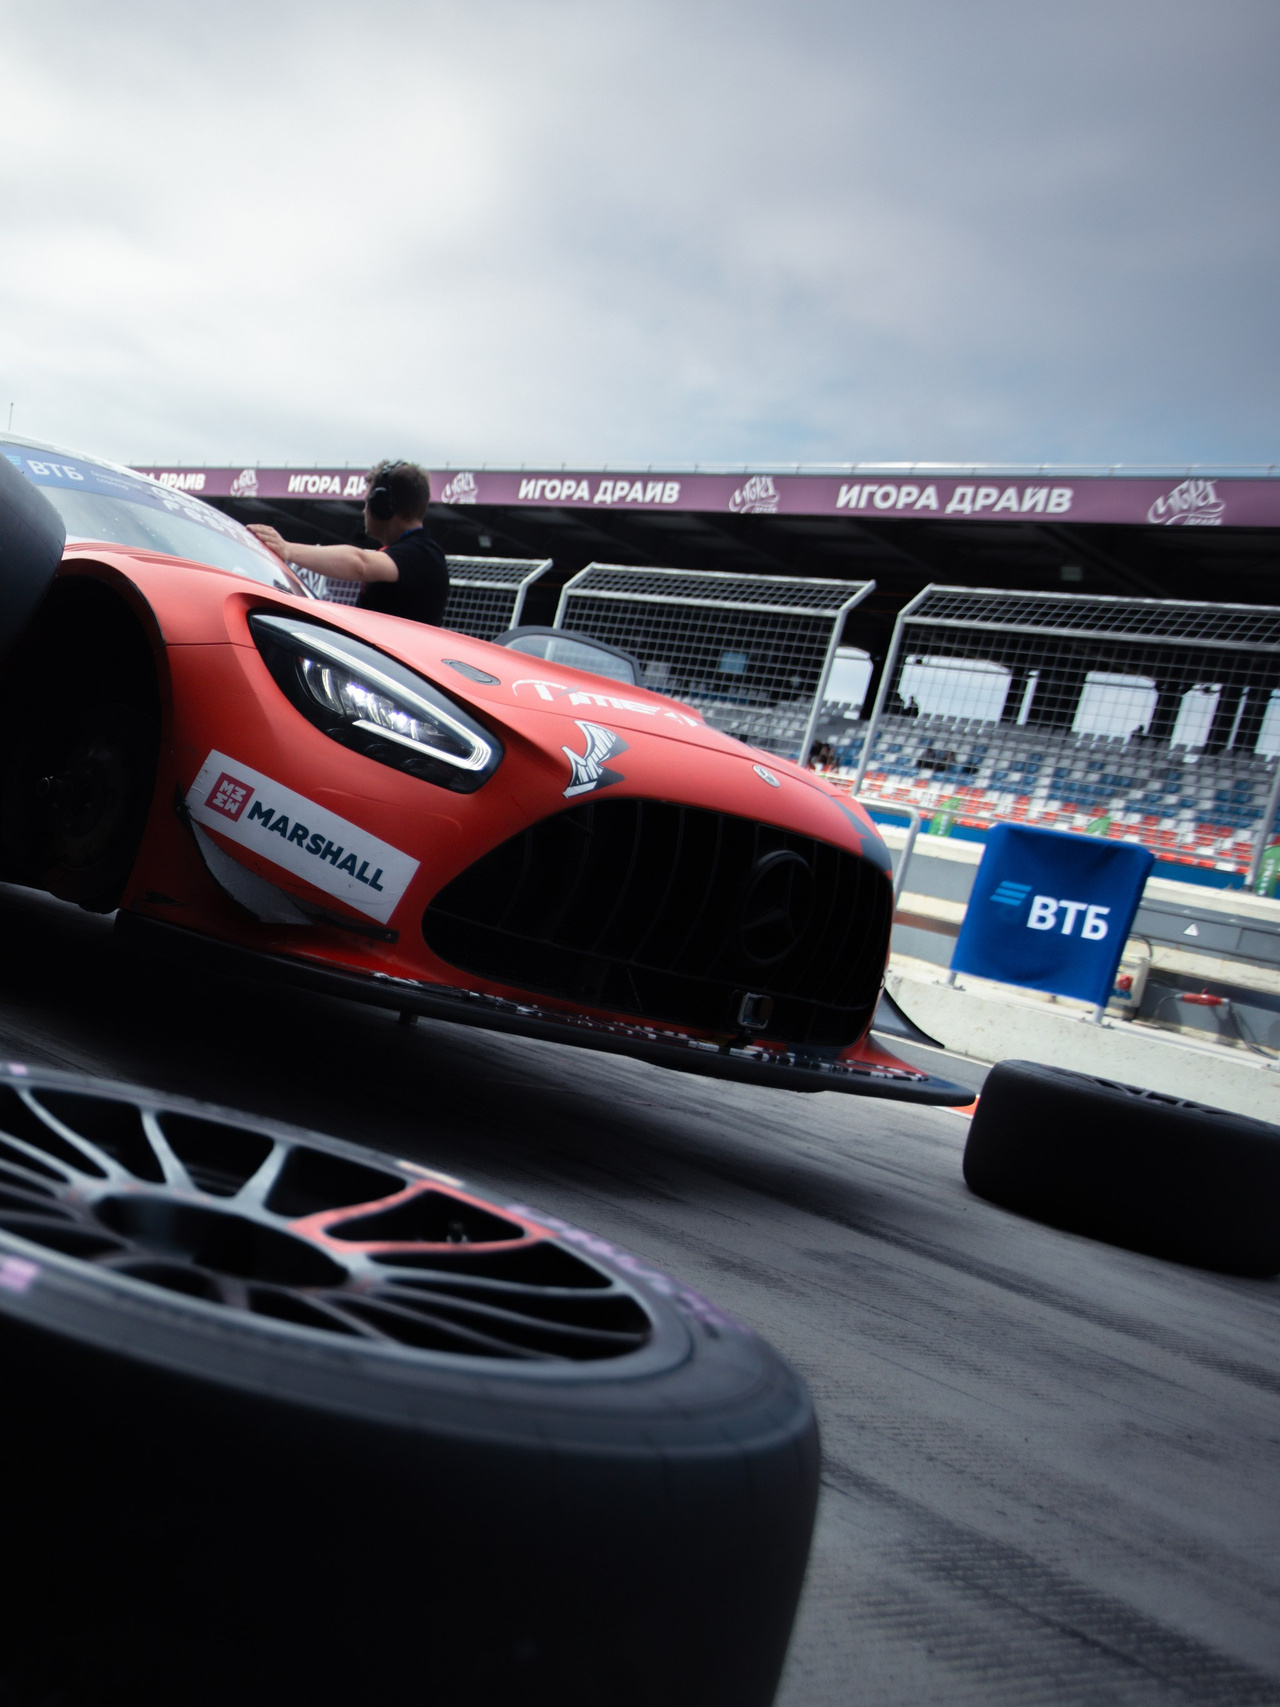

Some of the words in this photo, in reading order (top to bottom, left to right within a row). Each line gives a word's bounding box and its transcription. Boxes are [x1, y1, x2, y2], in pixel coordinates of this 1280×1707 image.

[26, 459, 84, 481] ВТБ
[287, 474, 341, 494] ИГОРА
[518, 478, 590, 501] ИГОРА
[593, 479, 680, 504] ДРАЙВ
[835, 484, 939, 510] ИГОРА
[944, 485, 1074, 514] ДРАЙВ
[246, 800, 383, 893] MARSHALL
[1026, 894, 1111, 941] ВТБ
